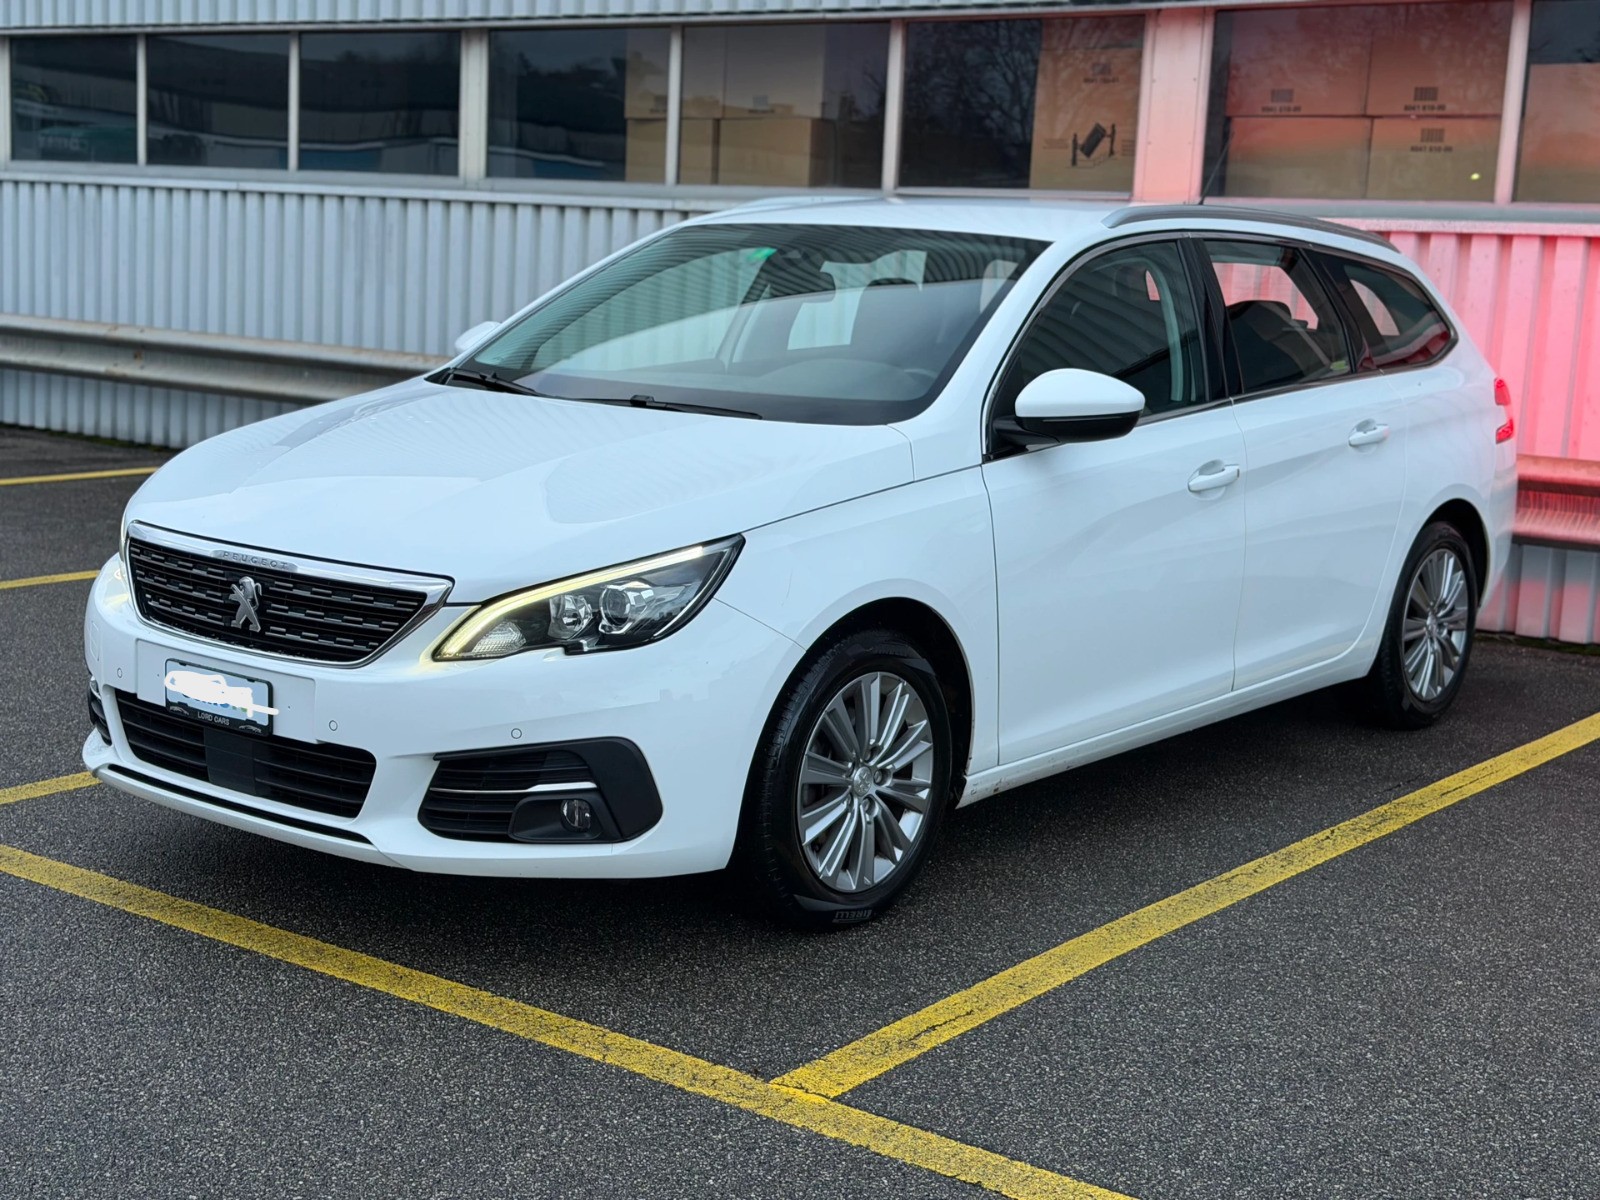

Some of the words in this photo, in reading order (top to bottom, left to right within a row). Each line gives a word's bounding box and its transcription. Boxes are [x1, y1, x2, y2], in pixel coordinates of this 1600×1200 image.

[222, 551, 288, 569] PEUGEOT
[197, 711, 213, 722] LORD
[213, 716, 230, 726] CARS
[833, 909, 873, 922] PIRELLI
